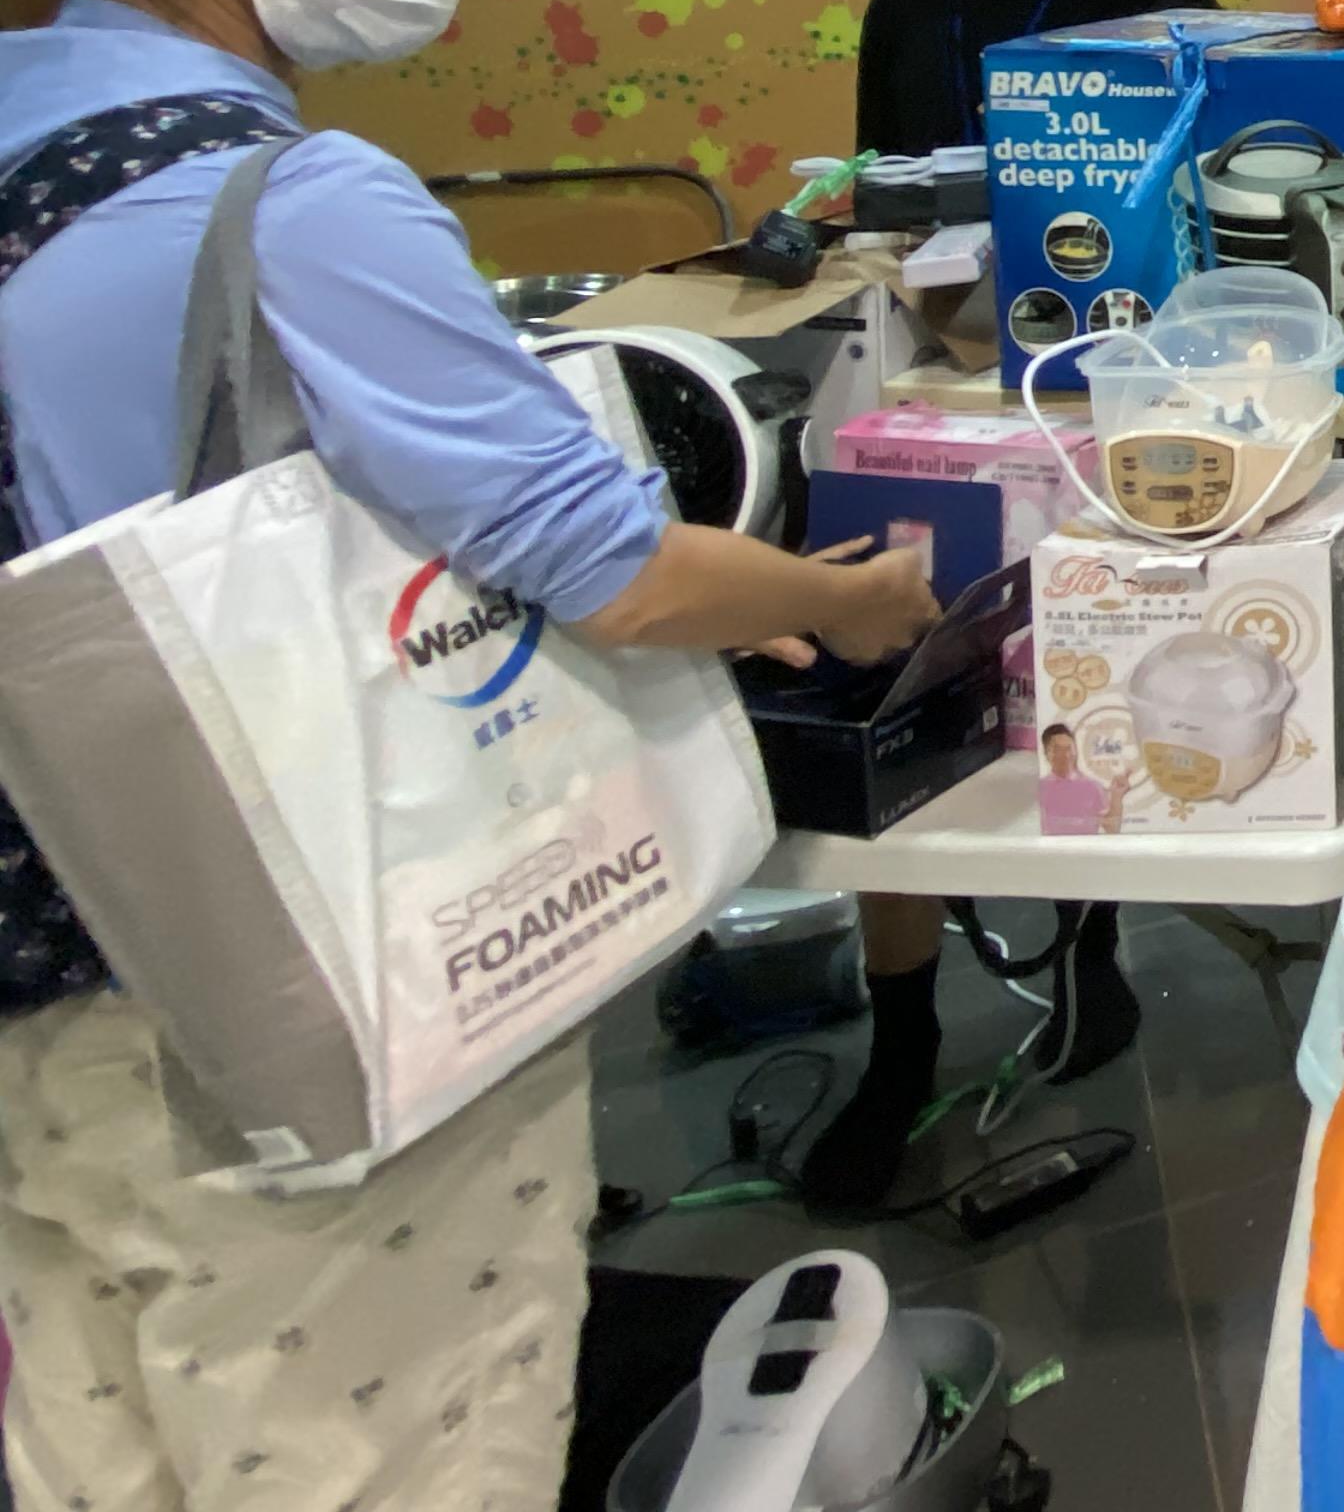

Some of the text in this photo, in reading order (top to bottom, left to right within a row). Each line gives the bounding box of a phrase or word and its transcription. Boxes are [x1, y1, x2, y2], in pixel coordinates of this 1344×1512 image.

[989, 71, 1107, 97] BRAVO
[1045, 112, 1110, 135] 3.0L
[999, 164, 1075, 193] deep
[944, 456, 977, 482] lamp
[1078, 611, 1135, 621] Electric
[1139, 612, 1174, 621] Stew
[1178, 612, 1203, 621] Pot
[446, 832, 662, 992] FOAMING
